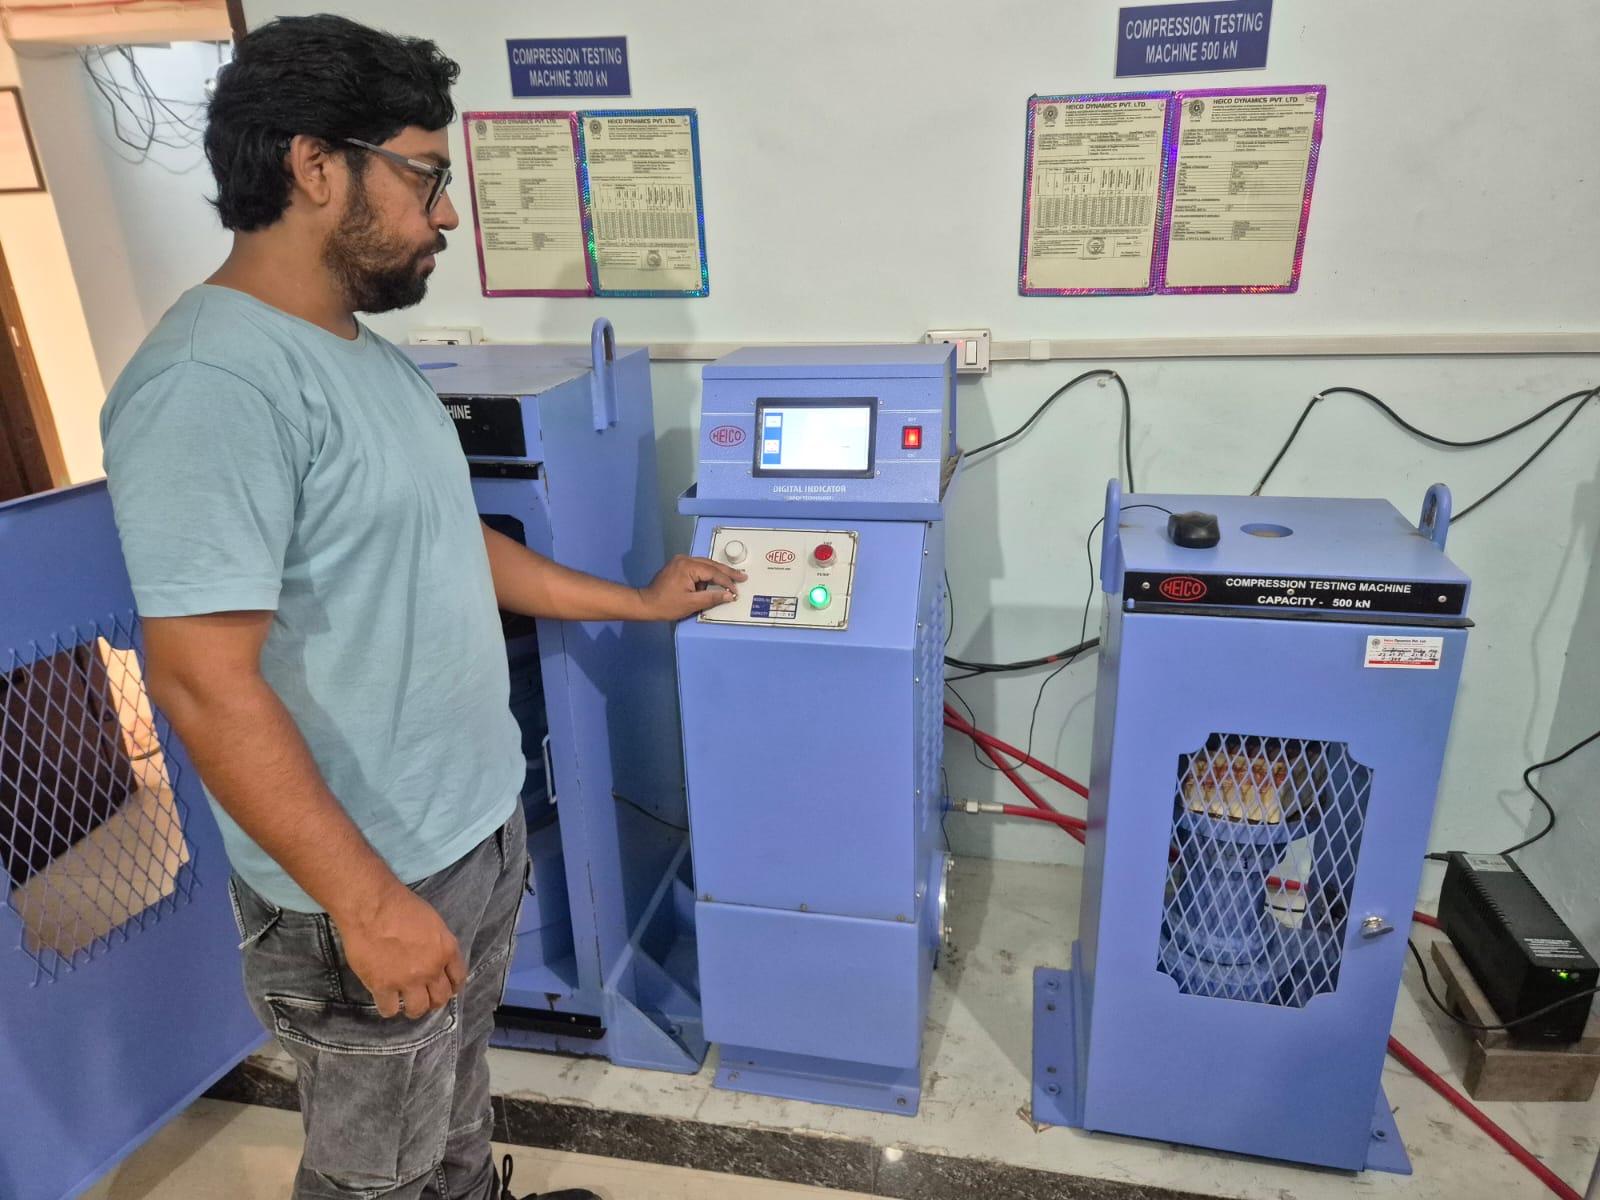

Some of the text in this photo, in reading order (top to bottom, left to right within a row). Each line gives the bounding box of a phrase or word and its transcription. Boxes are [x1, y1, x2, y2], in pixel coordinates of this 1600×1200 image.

[1126, 12, 1264, 39] COMPRESSION TESTING
[513, 47, 622, 65] COMPRESSION TESTING
[1146, 40, 1238, 64] MACHINE 500 kN
[529, 70, 608, 87] MACHINE 3000 kN
[446, 404, 472, 420] HINE
[712, 428, 742, 443] HEICO
[773, 485, 846, 493] DIGITAL INDICATOR
[1163, 580, 1202, 597] HEICO
[1225, 578, 1412, 593] COMPRESSION TESTING MACHINE
[1257, 595, 1317, 606] CAPACITY
[1332, 598, 1352, 607] 500
[1355, 600, 1371, 608] kN
